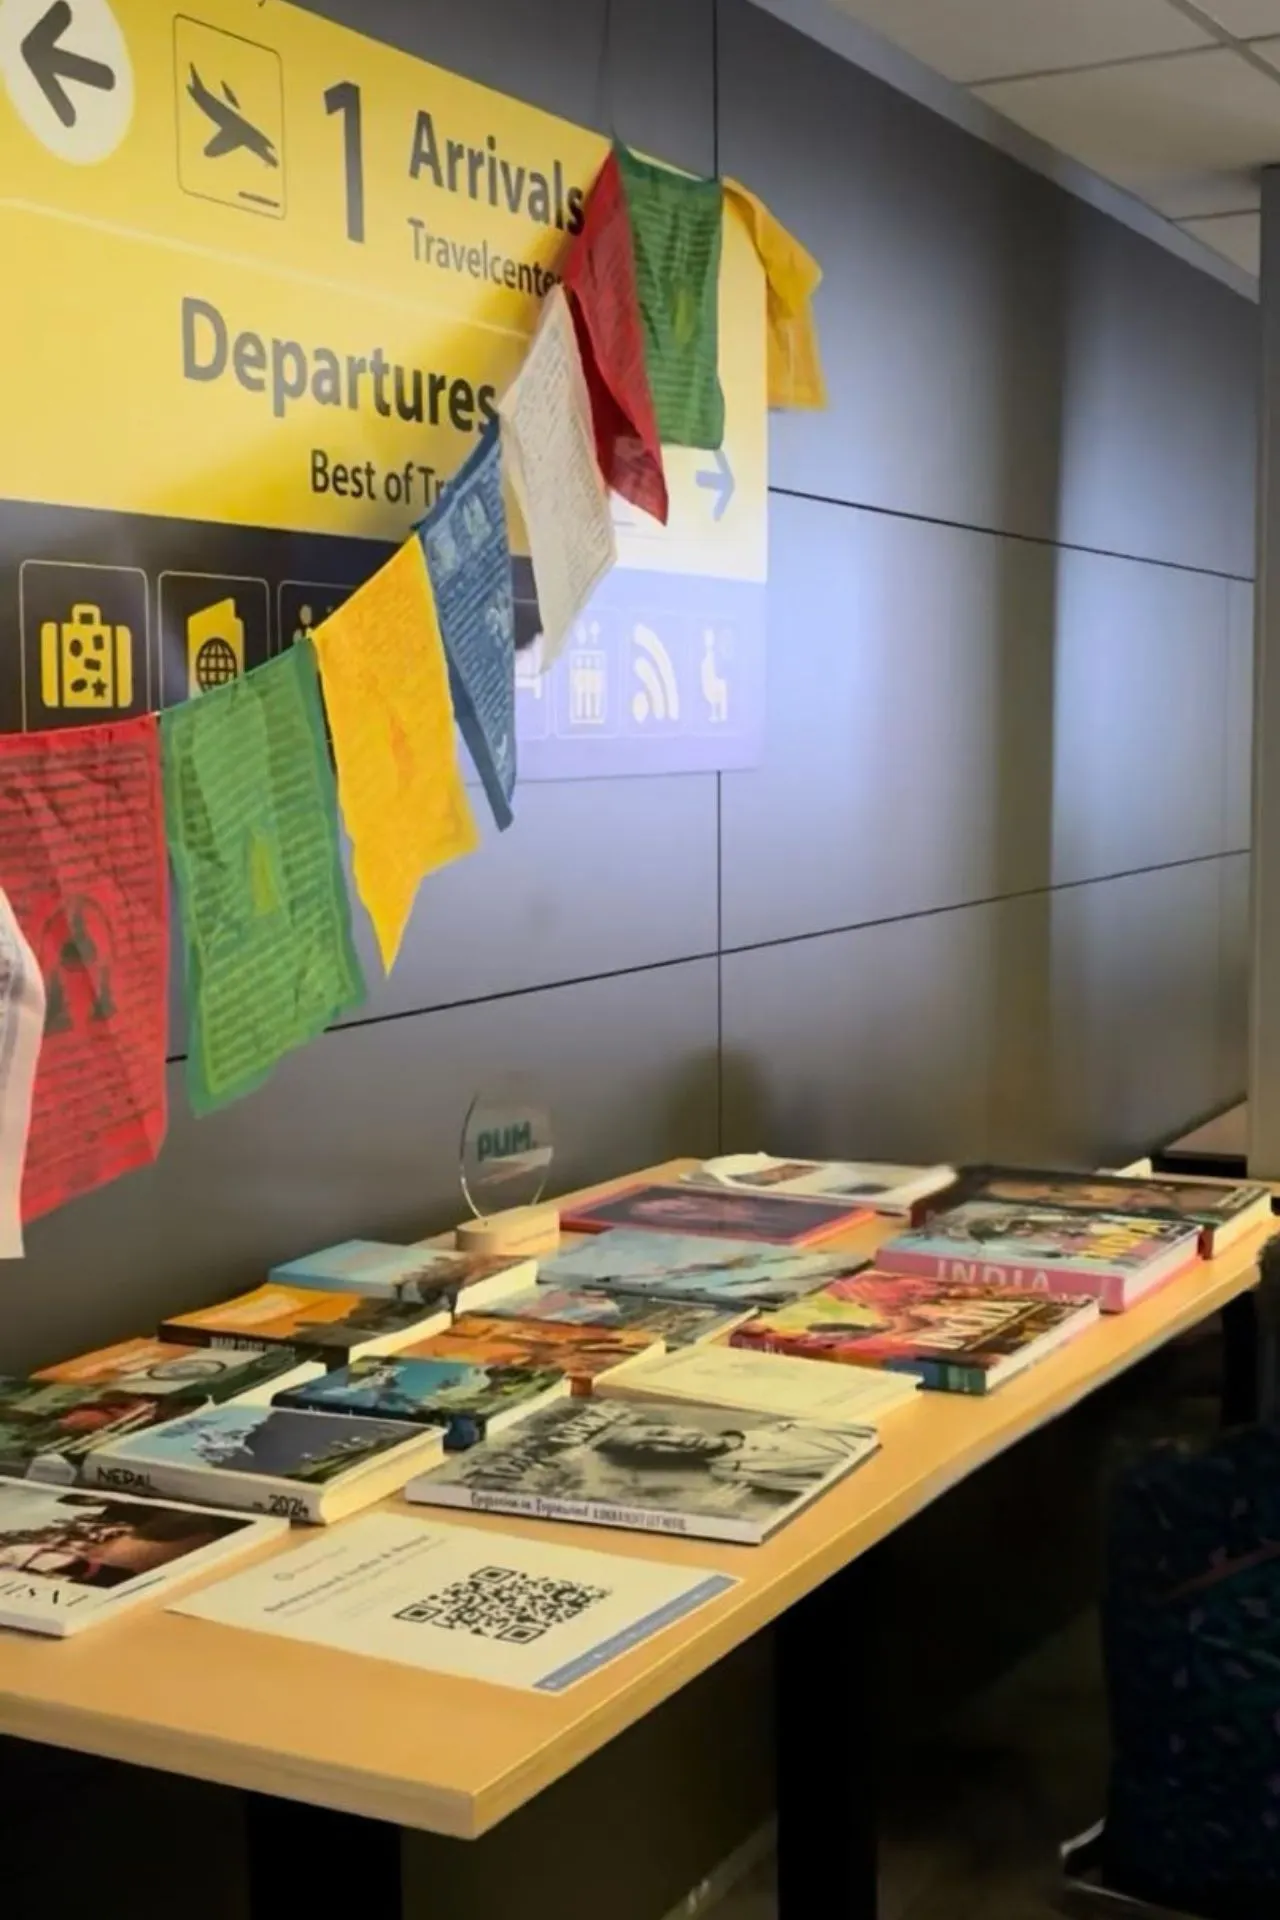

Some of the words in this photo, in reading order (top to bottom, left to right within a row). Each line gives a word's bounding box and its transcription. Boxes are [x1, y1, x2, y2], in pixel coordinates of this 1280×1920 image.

[324, 81, 364, 243] 1
[409, 110, 585, 236] Arrivals
[182, 297, 500, 436] Departures
[311, 448, 377, 500] Best
[384, 460, 415, 505] of
[936, 1259, 1050, 1291] INDIA
